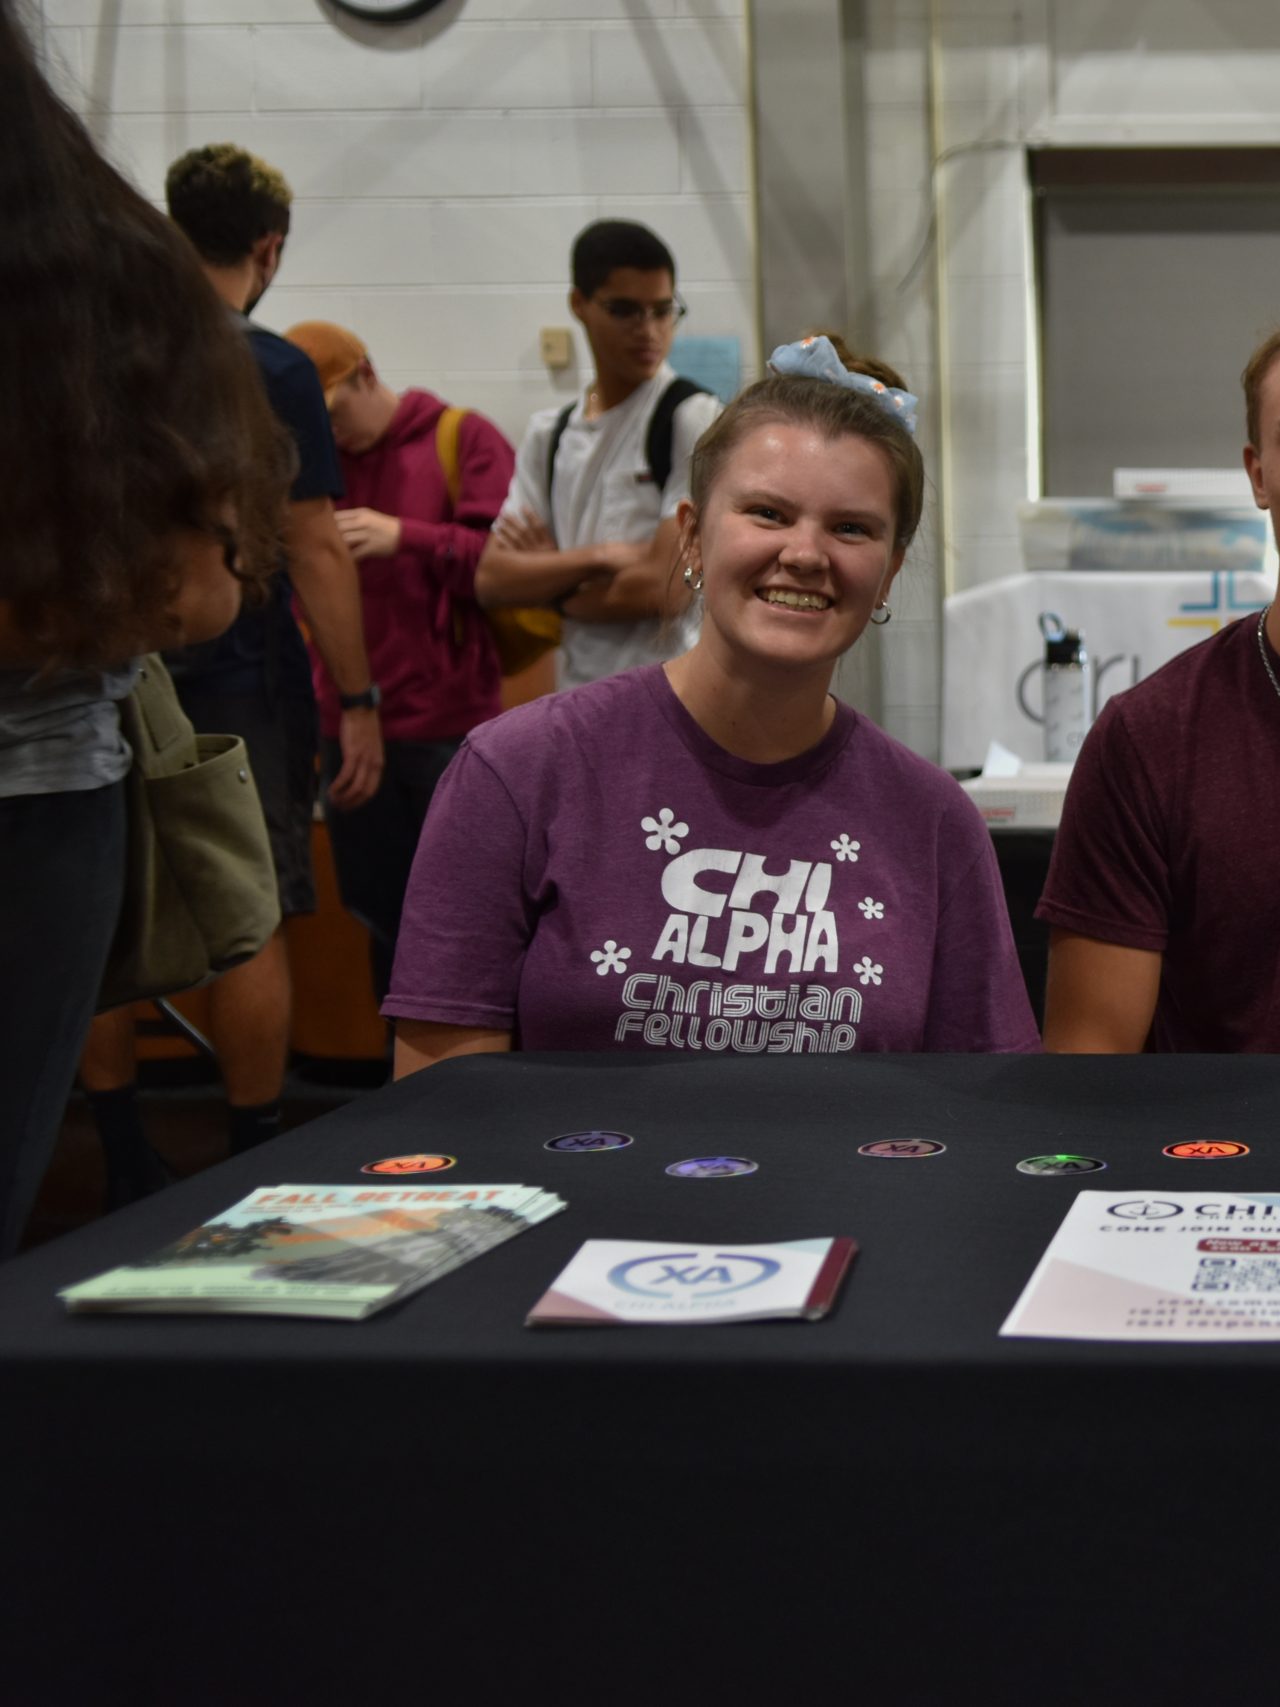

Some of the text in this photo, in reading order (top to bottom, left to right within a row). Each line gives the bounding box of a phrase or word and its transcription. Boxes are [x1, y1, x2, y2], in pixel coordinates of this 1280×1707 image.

[661, 848, 832, 918] CHI
[651, 910, 839, 974] ALPHA
[621, 973, 863, 1023] Christian
[614, 1011, 857, 1053] Fellowship
[353, 1190, 504, 1201] RETREAT
[1194, 1203, 1274, 1217] CHI
[650, 1264, 733, 1285] XA
